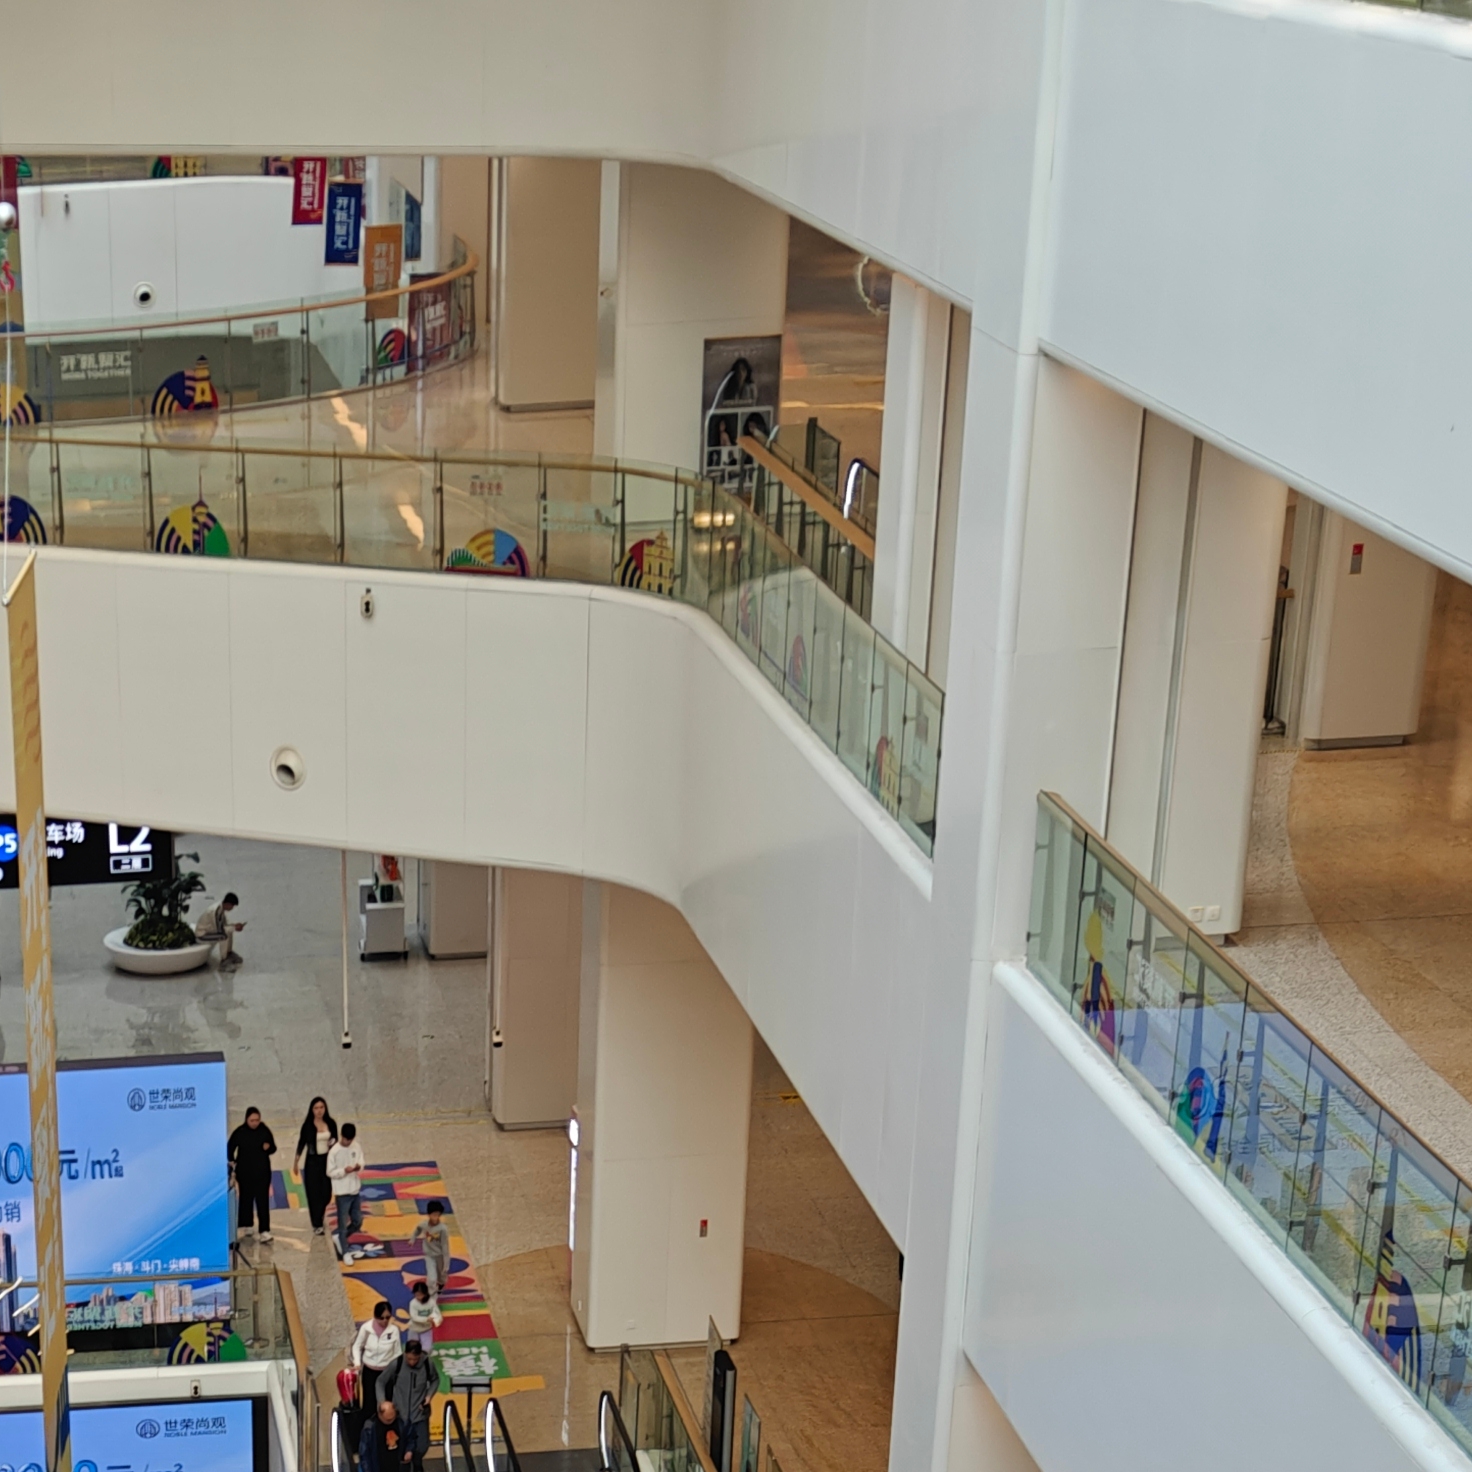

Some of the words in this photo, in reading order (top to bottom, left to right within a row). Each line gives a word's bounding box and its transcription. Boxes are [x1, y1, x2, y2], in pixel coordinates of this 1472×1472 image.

[46, 821, 85, 845] 车场
[148, 1087, 196, 1104] 世荣尚观
[163, 1416, 226, 1431] 世荣尚观
